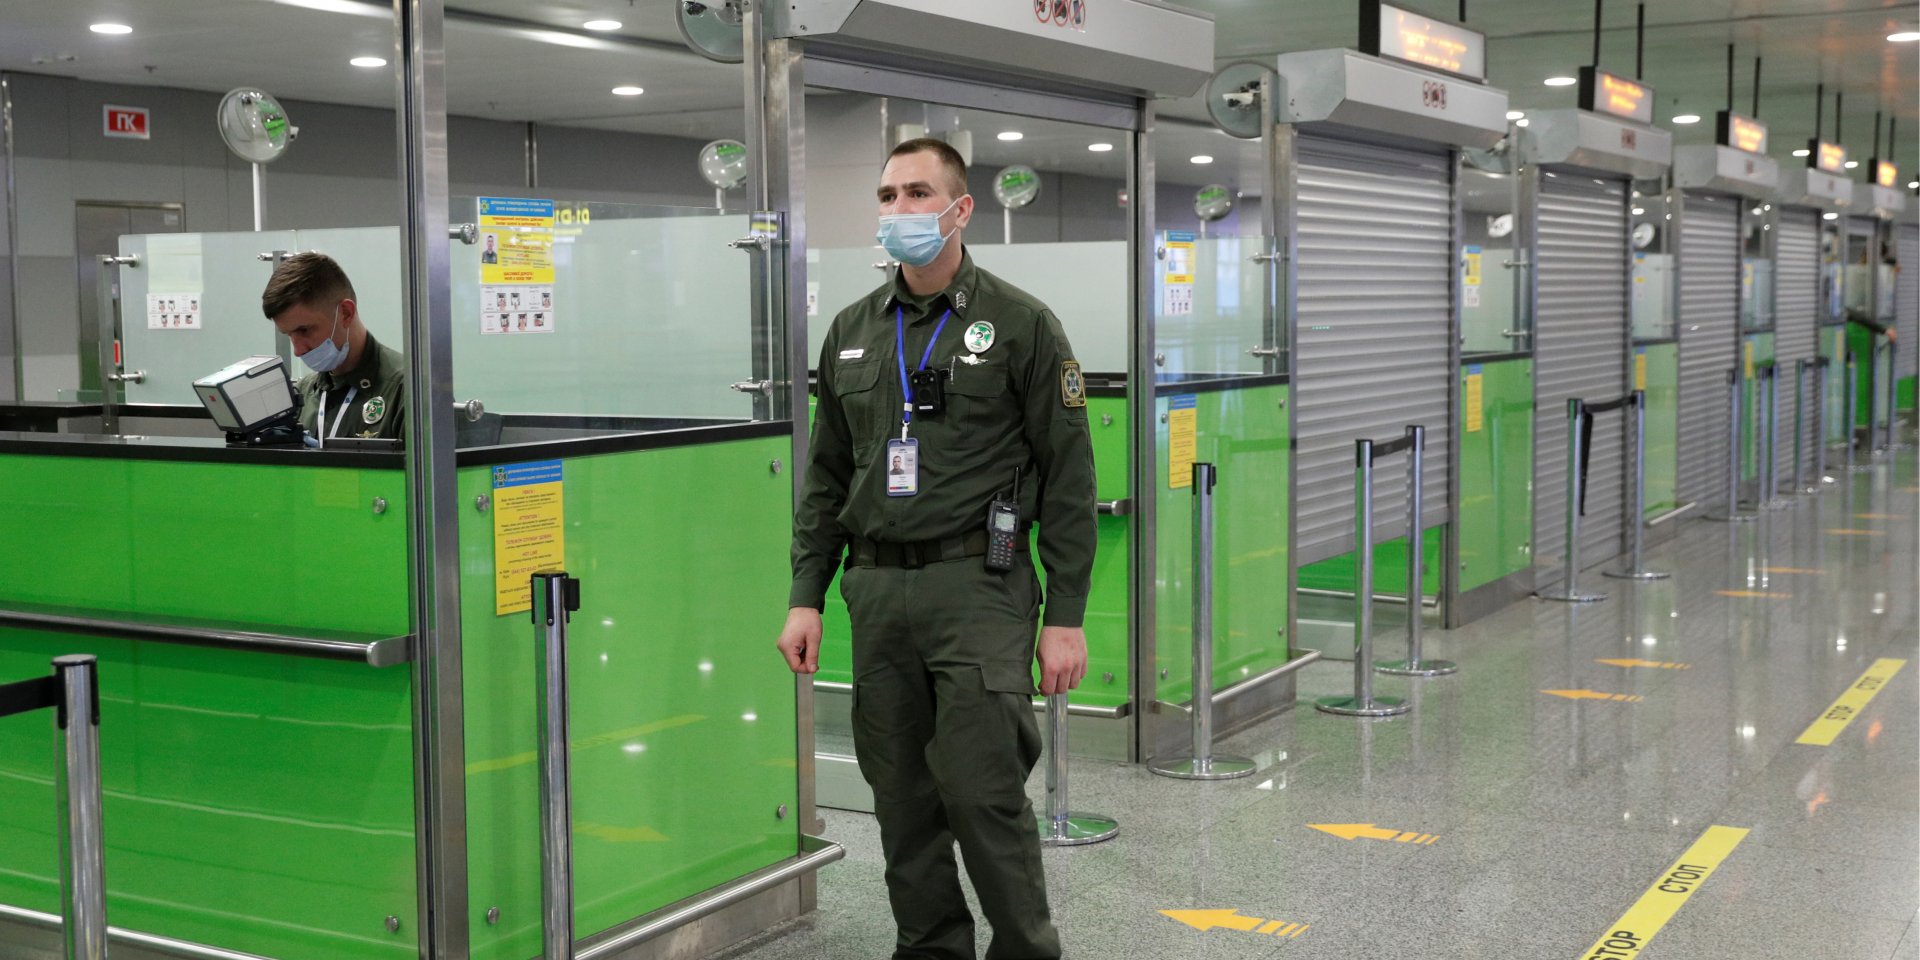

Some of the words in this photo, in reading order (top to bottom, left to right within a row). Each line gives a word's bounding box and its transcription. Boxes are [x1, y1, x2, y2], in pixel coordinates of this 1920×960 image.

[117, 112, 137, 131] ПК
[1824, 704, 1854, 720] STOP
[1658, 864, 1708, 893] СТОП
